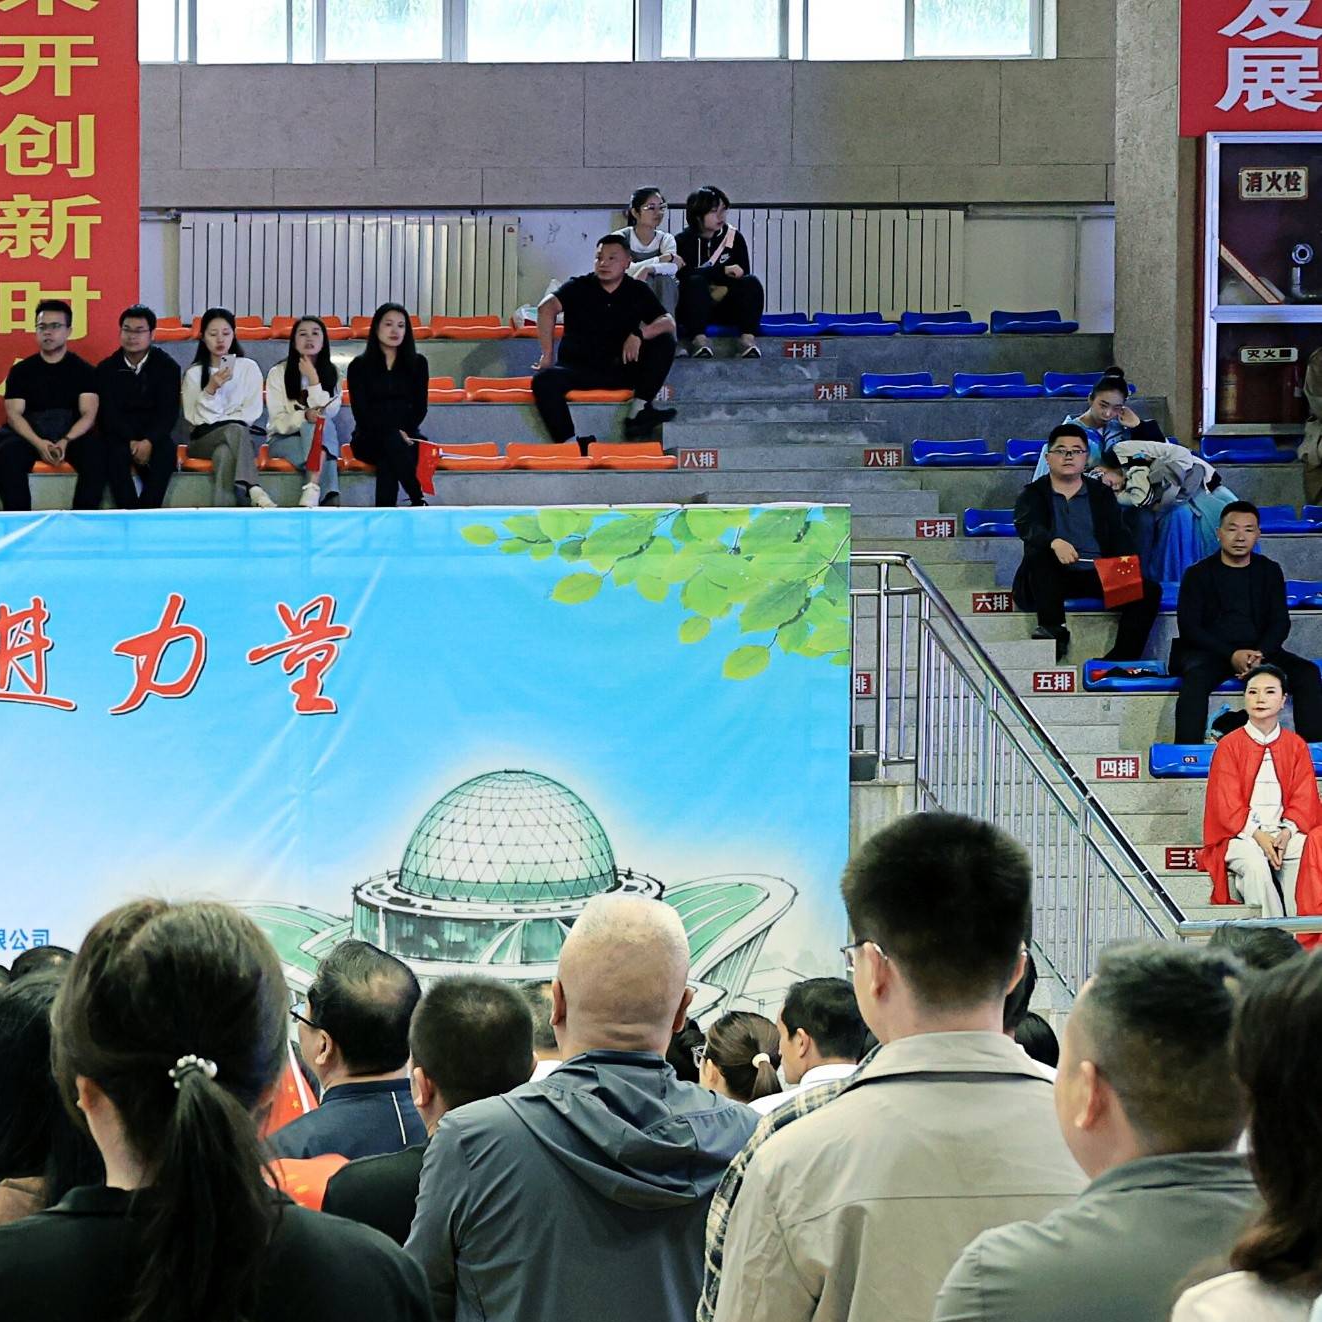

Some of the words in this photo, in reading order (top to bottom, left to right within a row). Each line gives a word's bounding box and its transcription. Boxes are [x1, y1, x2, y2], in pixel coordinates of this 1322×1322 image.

[1245, 172, 1302, 193] 消火栓
[788, 343, 818, 358] 十排
[817, 384, 848, 400] 九排
[684, 451, 716, 467] 八排
[868, 450, 900, 466] 八排
[919, 521, 952, 538] 七排
[975, 595, 1010, 611] 六排
[1036, 673, 1071, 691] 五排
[1100, 760, 1136, 777] 四排
